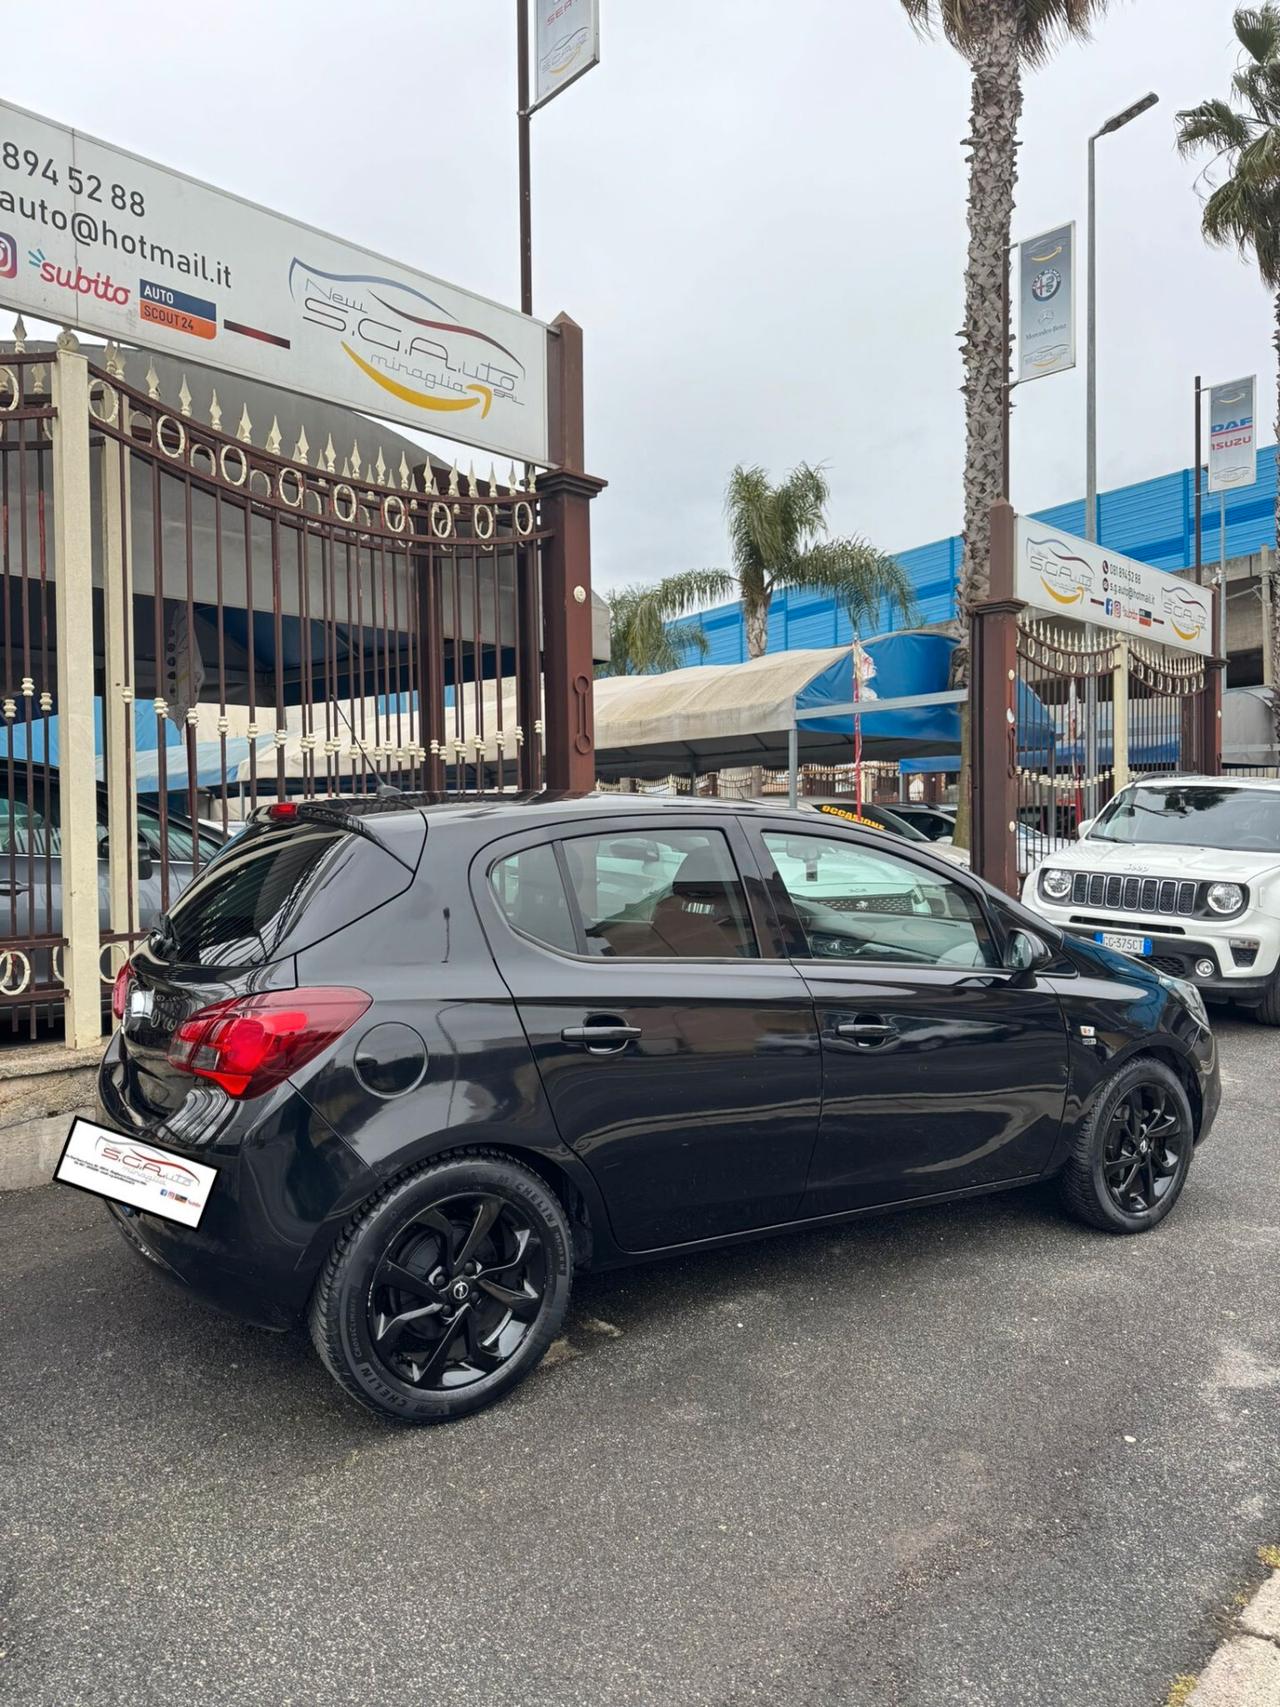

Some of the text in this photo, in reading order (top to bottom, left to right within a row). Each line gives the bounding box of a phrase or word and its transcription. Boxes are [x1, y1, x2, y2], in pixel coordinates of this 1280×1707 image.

[547, 0, 578, 26] SEA
[2, 141, 146, 218] 894 52 88
[0, 190, 232, 289] auto@hotmail.it
[39, 261, 131, 306] subito
[143, 284, 174, 305] AUTO
[304, 278, 368, 314] New
[1211, 416, 1253, 434] DAF
[1211, 435, 1252, 451] ISUZU
